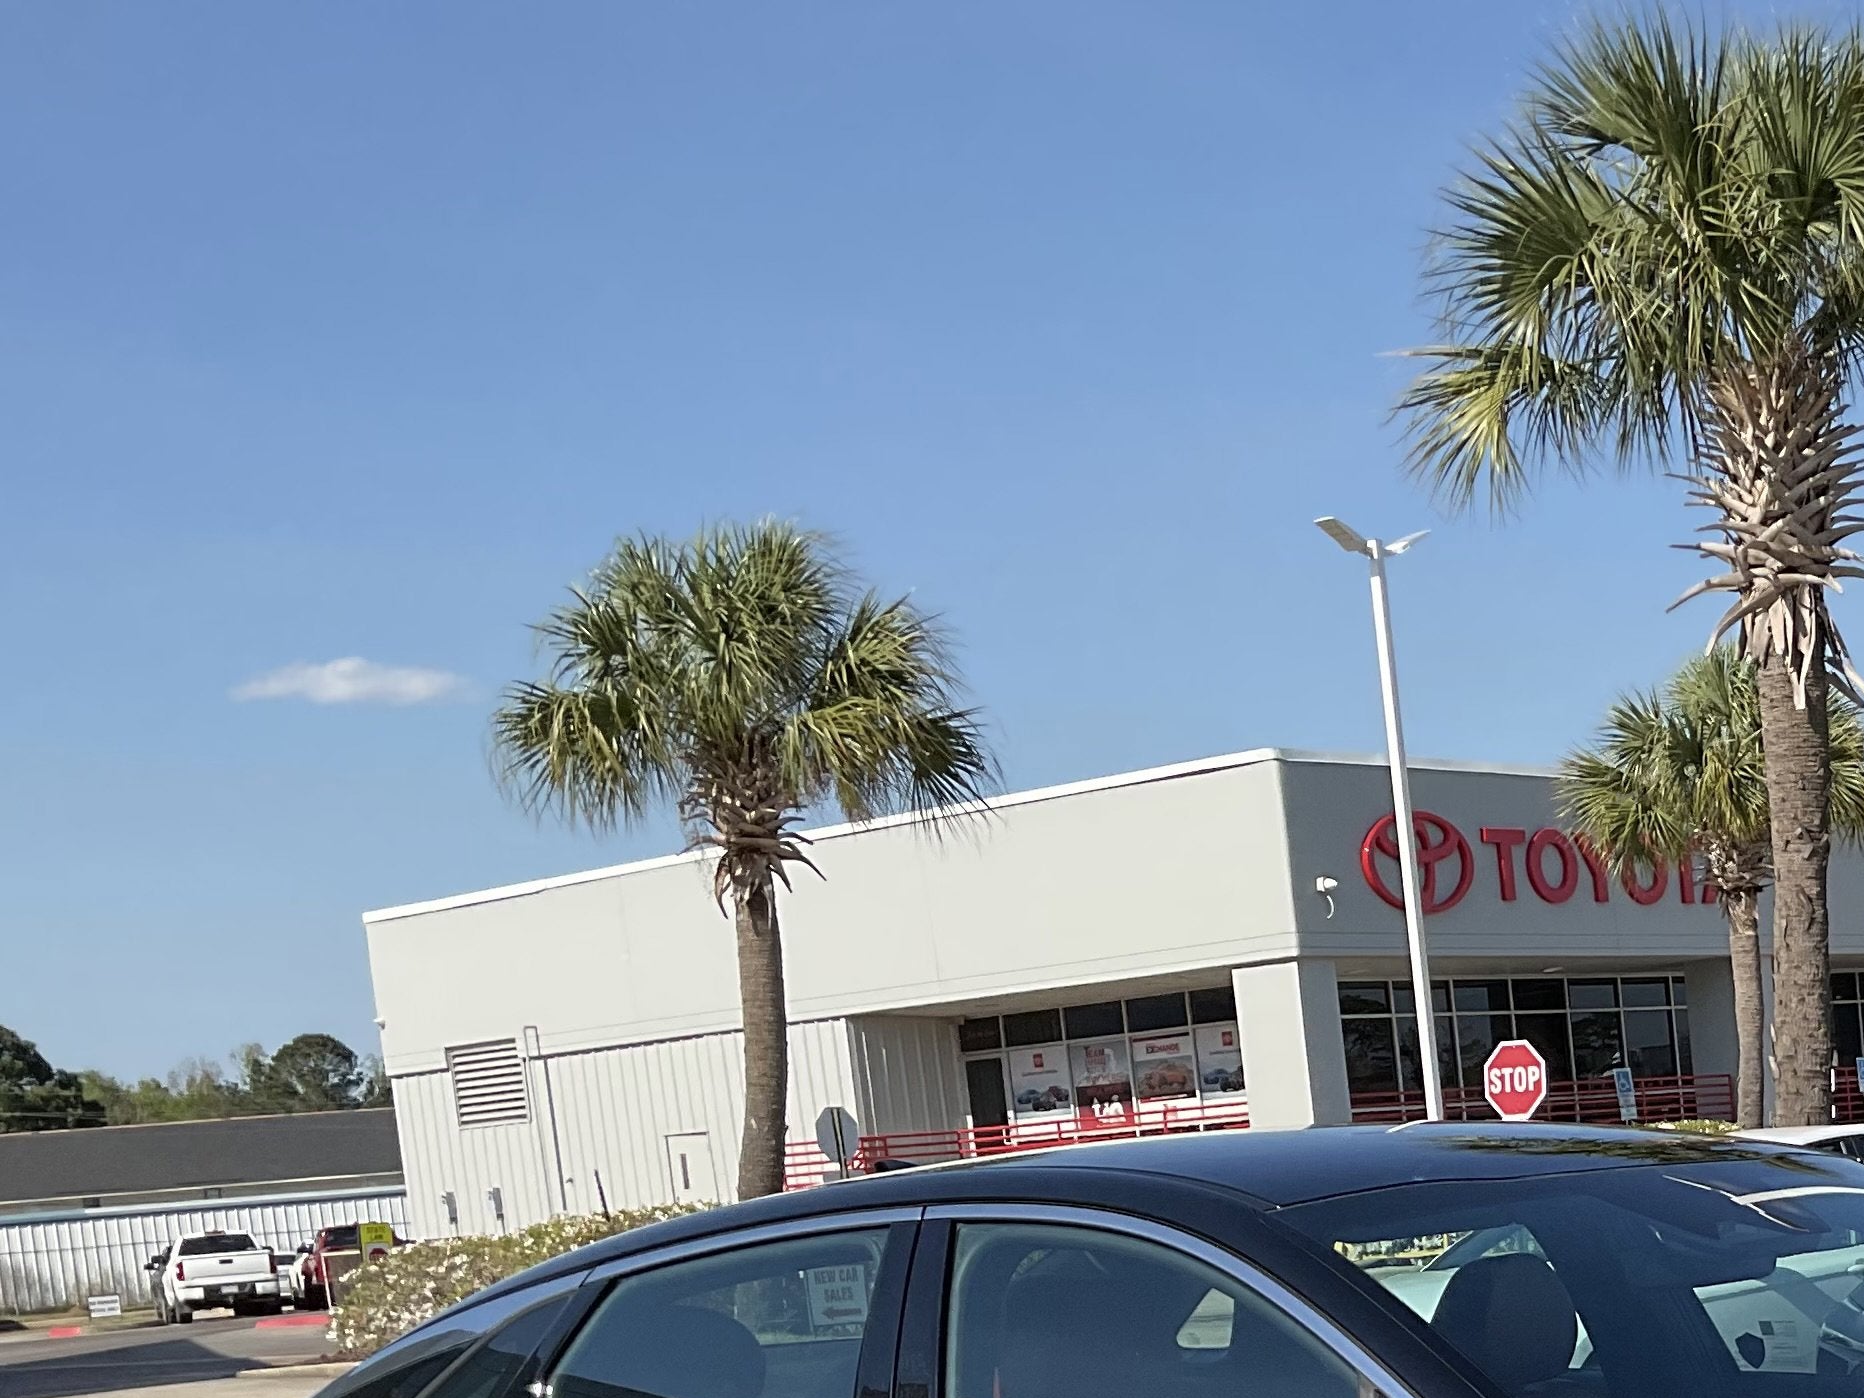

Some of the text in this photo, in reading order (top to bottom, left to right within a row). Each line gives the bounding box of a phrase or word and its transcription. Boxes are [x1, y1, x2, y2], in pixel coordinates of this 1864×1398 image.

[1489, 1065, 1540, 1094] STOP
[813, 1266, 859, 1285] NEW CAR
[823, 1286, 854, 1303] SALES
